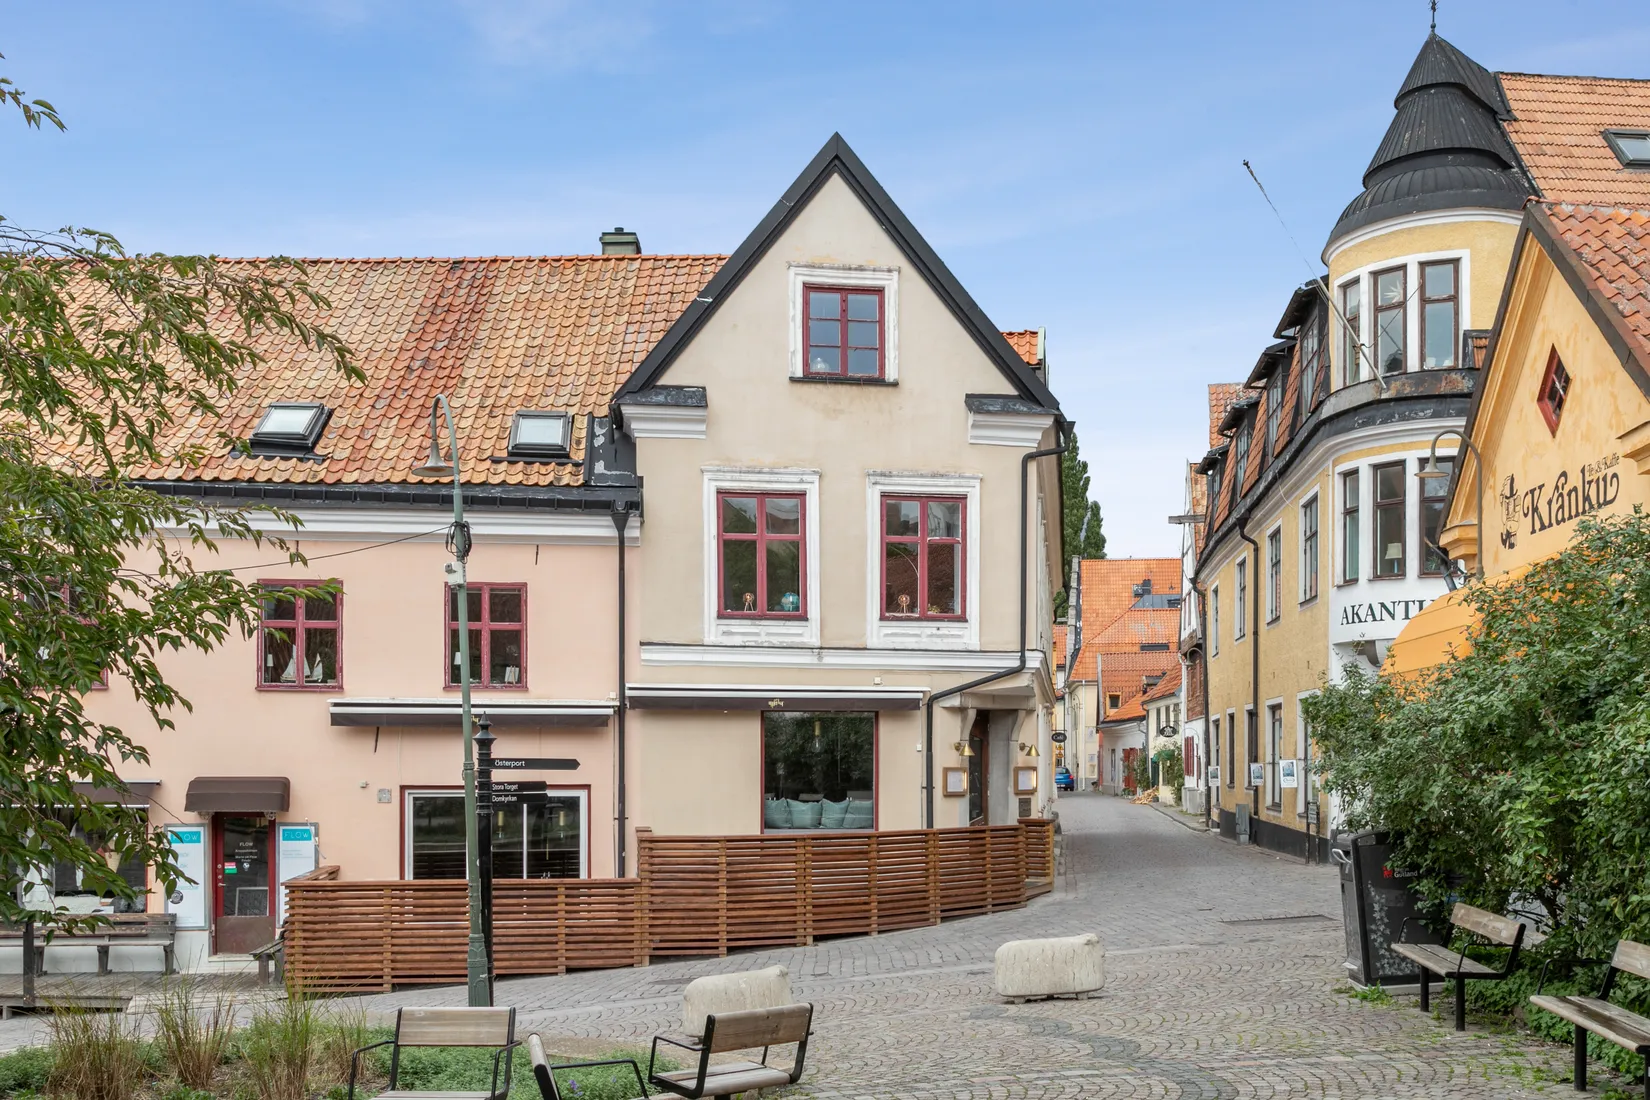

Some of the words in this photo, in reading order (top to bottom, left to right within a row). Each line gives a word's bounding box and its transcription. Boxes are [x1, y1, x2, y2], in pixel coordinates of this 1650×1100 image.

[494, 760, 525, 768] Österport
[492, 795, 517, 803] Domkyrkan
[284, 831, 309, 839] FLOW
